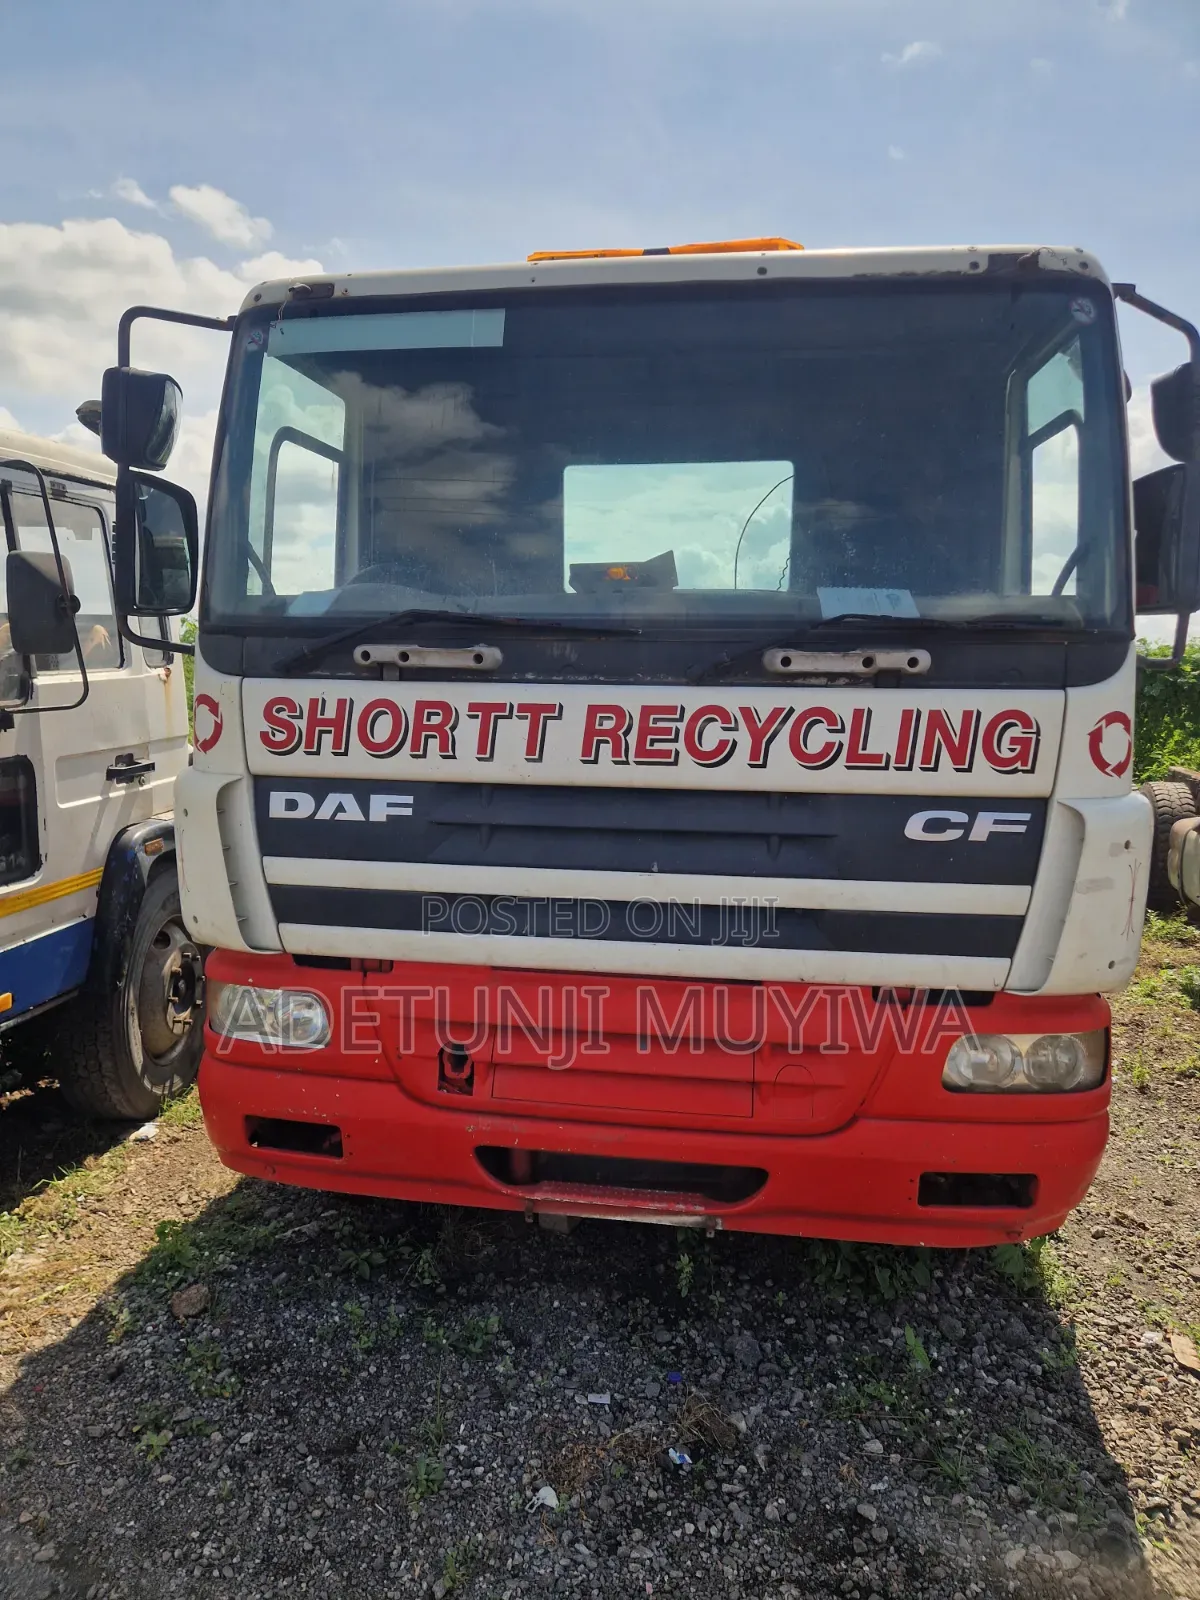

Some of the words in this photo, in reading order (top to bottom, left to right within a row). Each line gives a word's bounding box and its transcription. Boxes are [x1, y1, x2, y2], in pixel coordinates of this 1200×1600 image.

[259, 696, 563, 762] SHORTT
[580, 702, 1041, 774] RECYCLING
[269, 791, 414, 822] DAF
[904, 811, 1031, 841] CF
